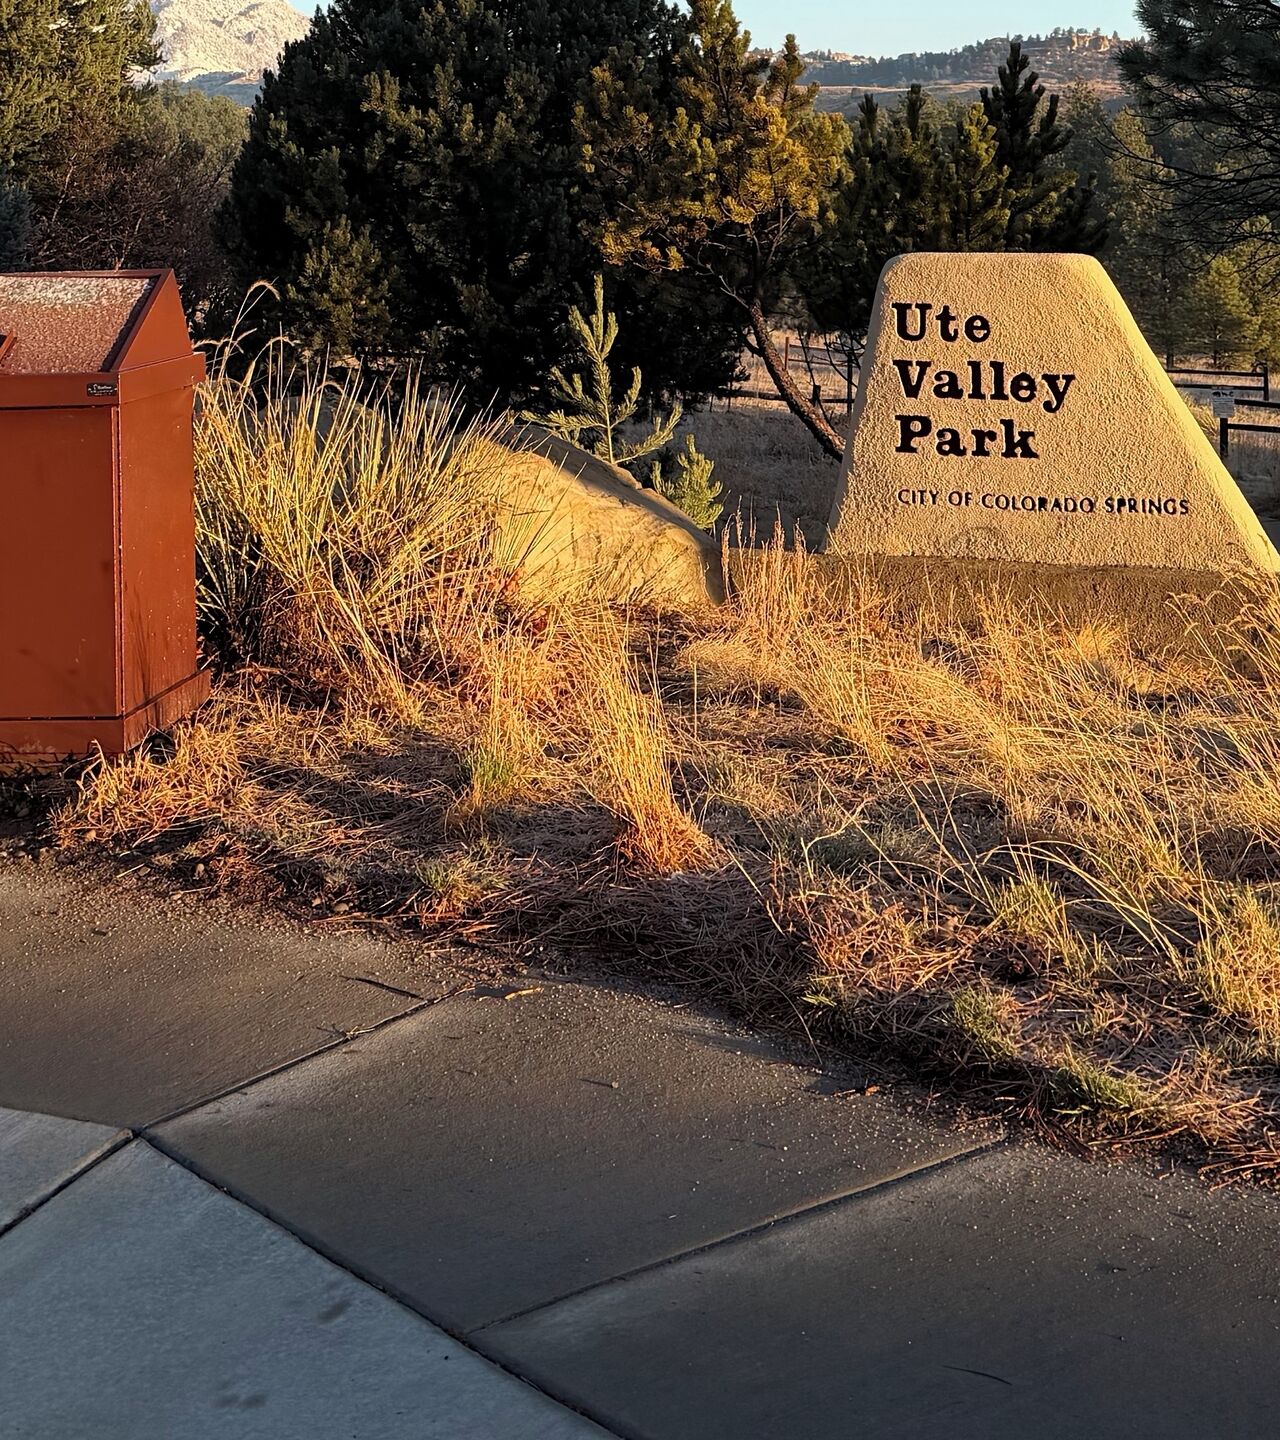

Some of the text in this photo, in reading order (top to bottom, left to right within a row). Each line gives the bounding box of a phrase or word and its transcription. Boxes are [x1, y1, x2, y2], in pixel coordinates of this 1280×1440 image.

[891, 302, 991, 343] Ute
[892, 360, 1076, 413] Valley
[894, 414, 1040, 459] Park
[896, 488, 1191, 516] CITY OF COLORADO SPRINGS
